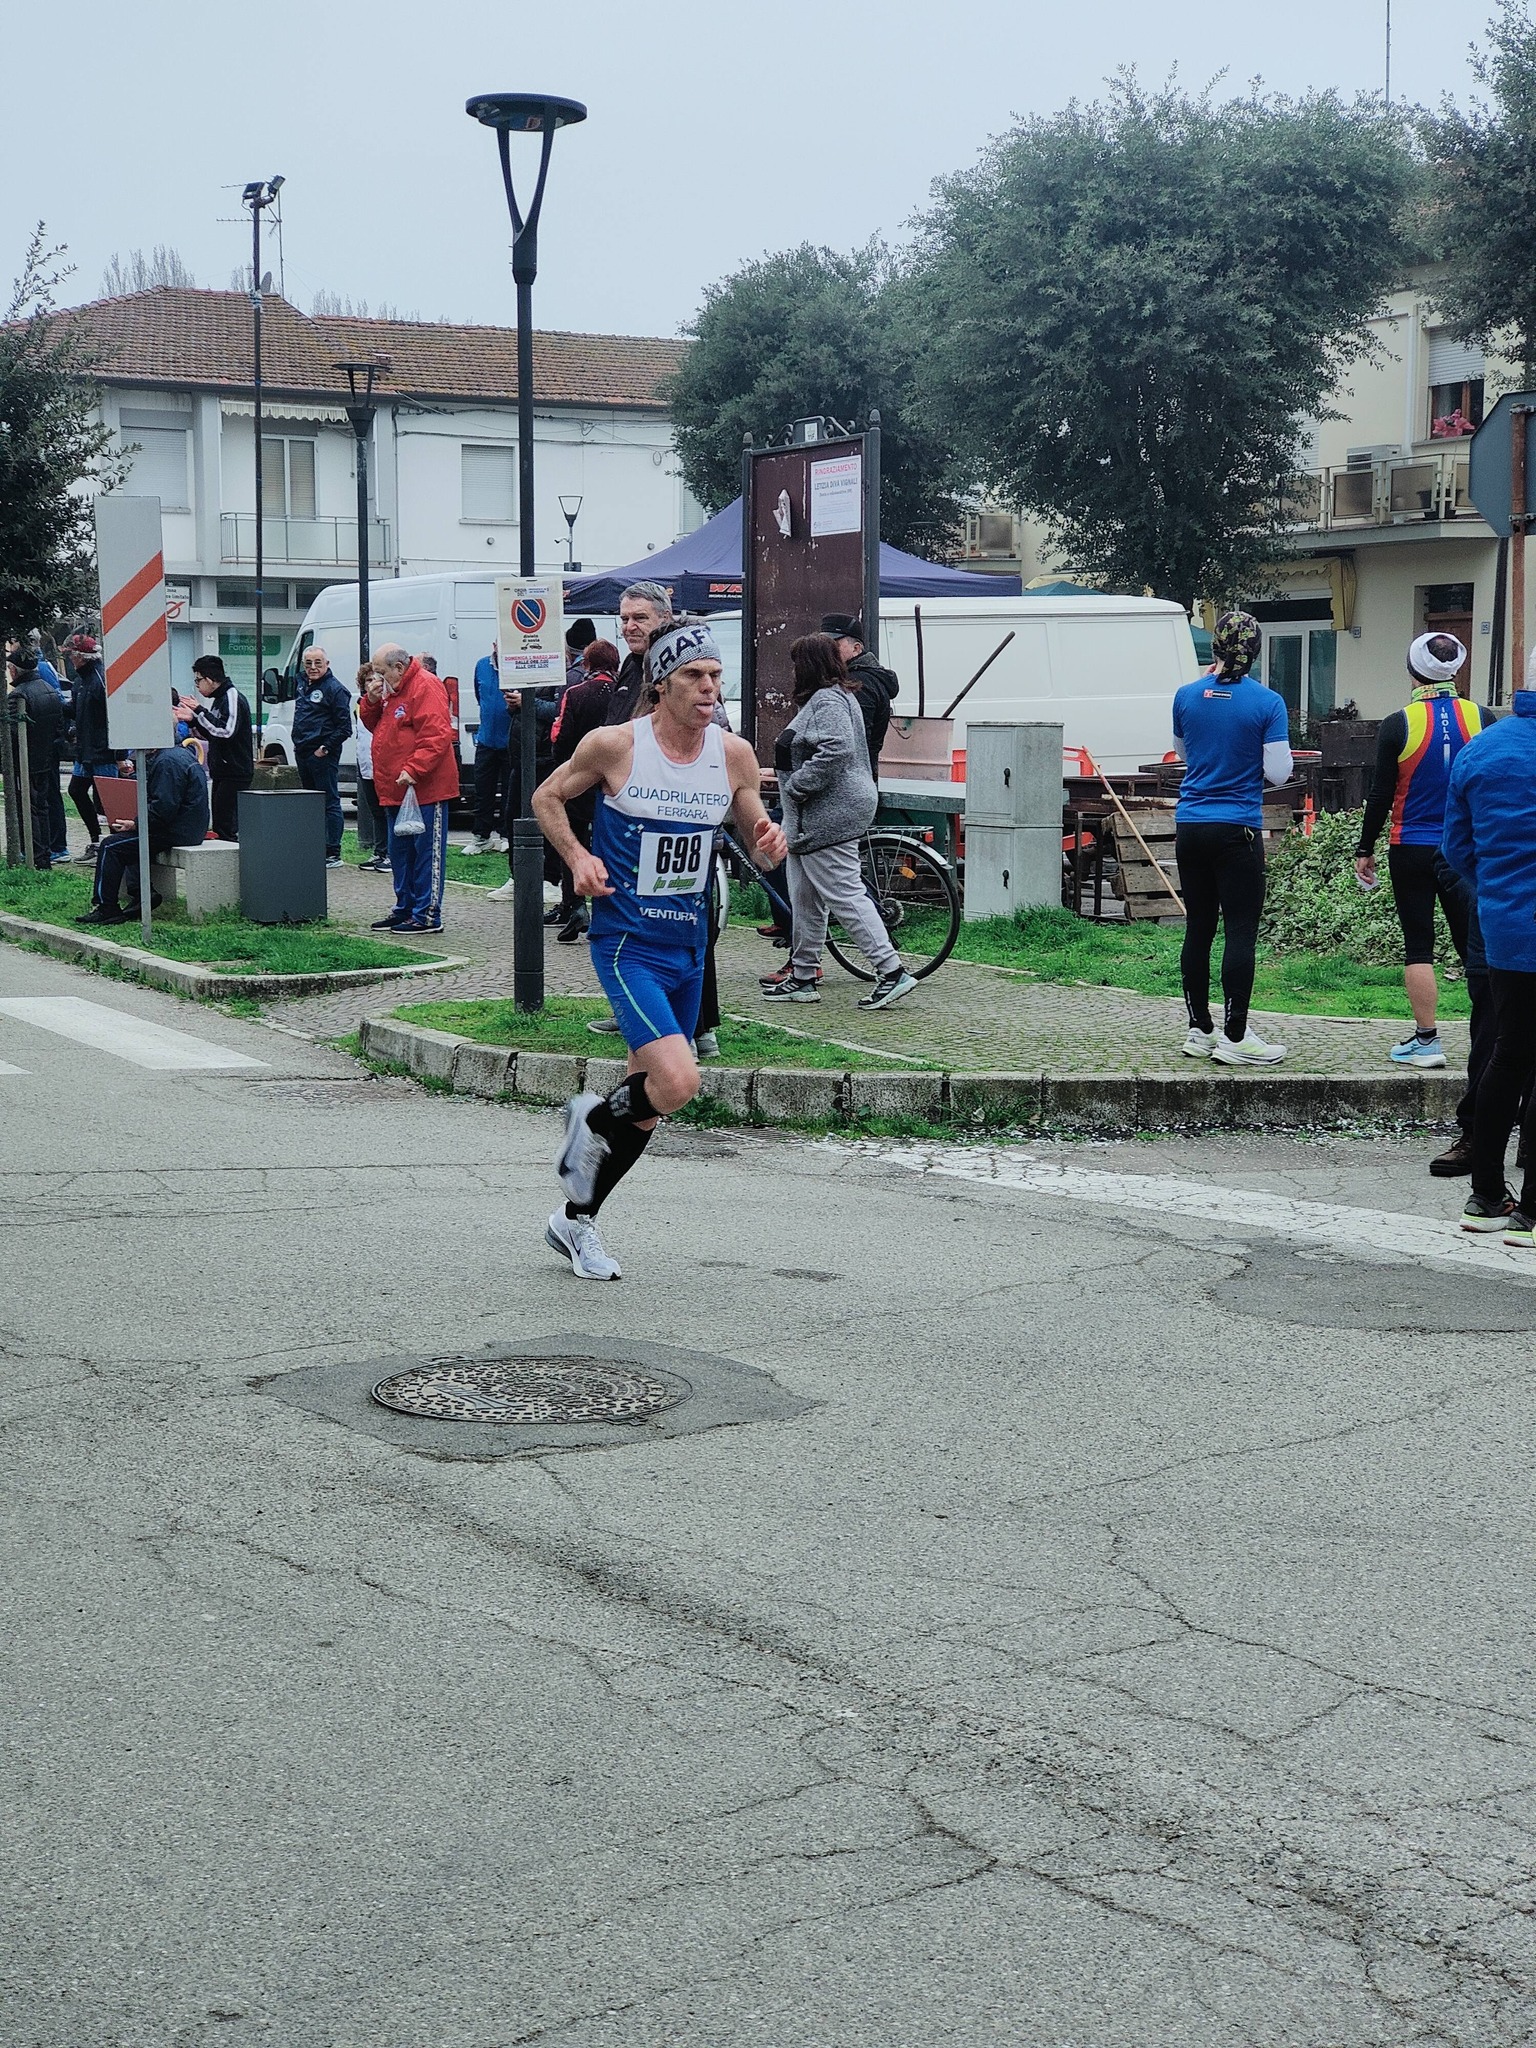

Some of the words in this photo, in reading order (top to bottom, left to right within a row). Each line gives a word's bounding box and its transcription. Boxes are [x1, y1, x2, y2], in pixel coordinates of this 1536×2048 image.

[1441, 706, 1450, 741] IMOLA
[627, 785, 730, 807] QUADRILATERO
[657, 805, 709, 820] FERRARA
[656, 834, 702, 874] 698
